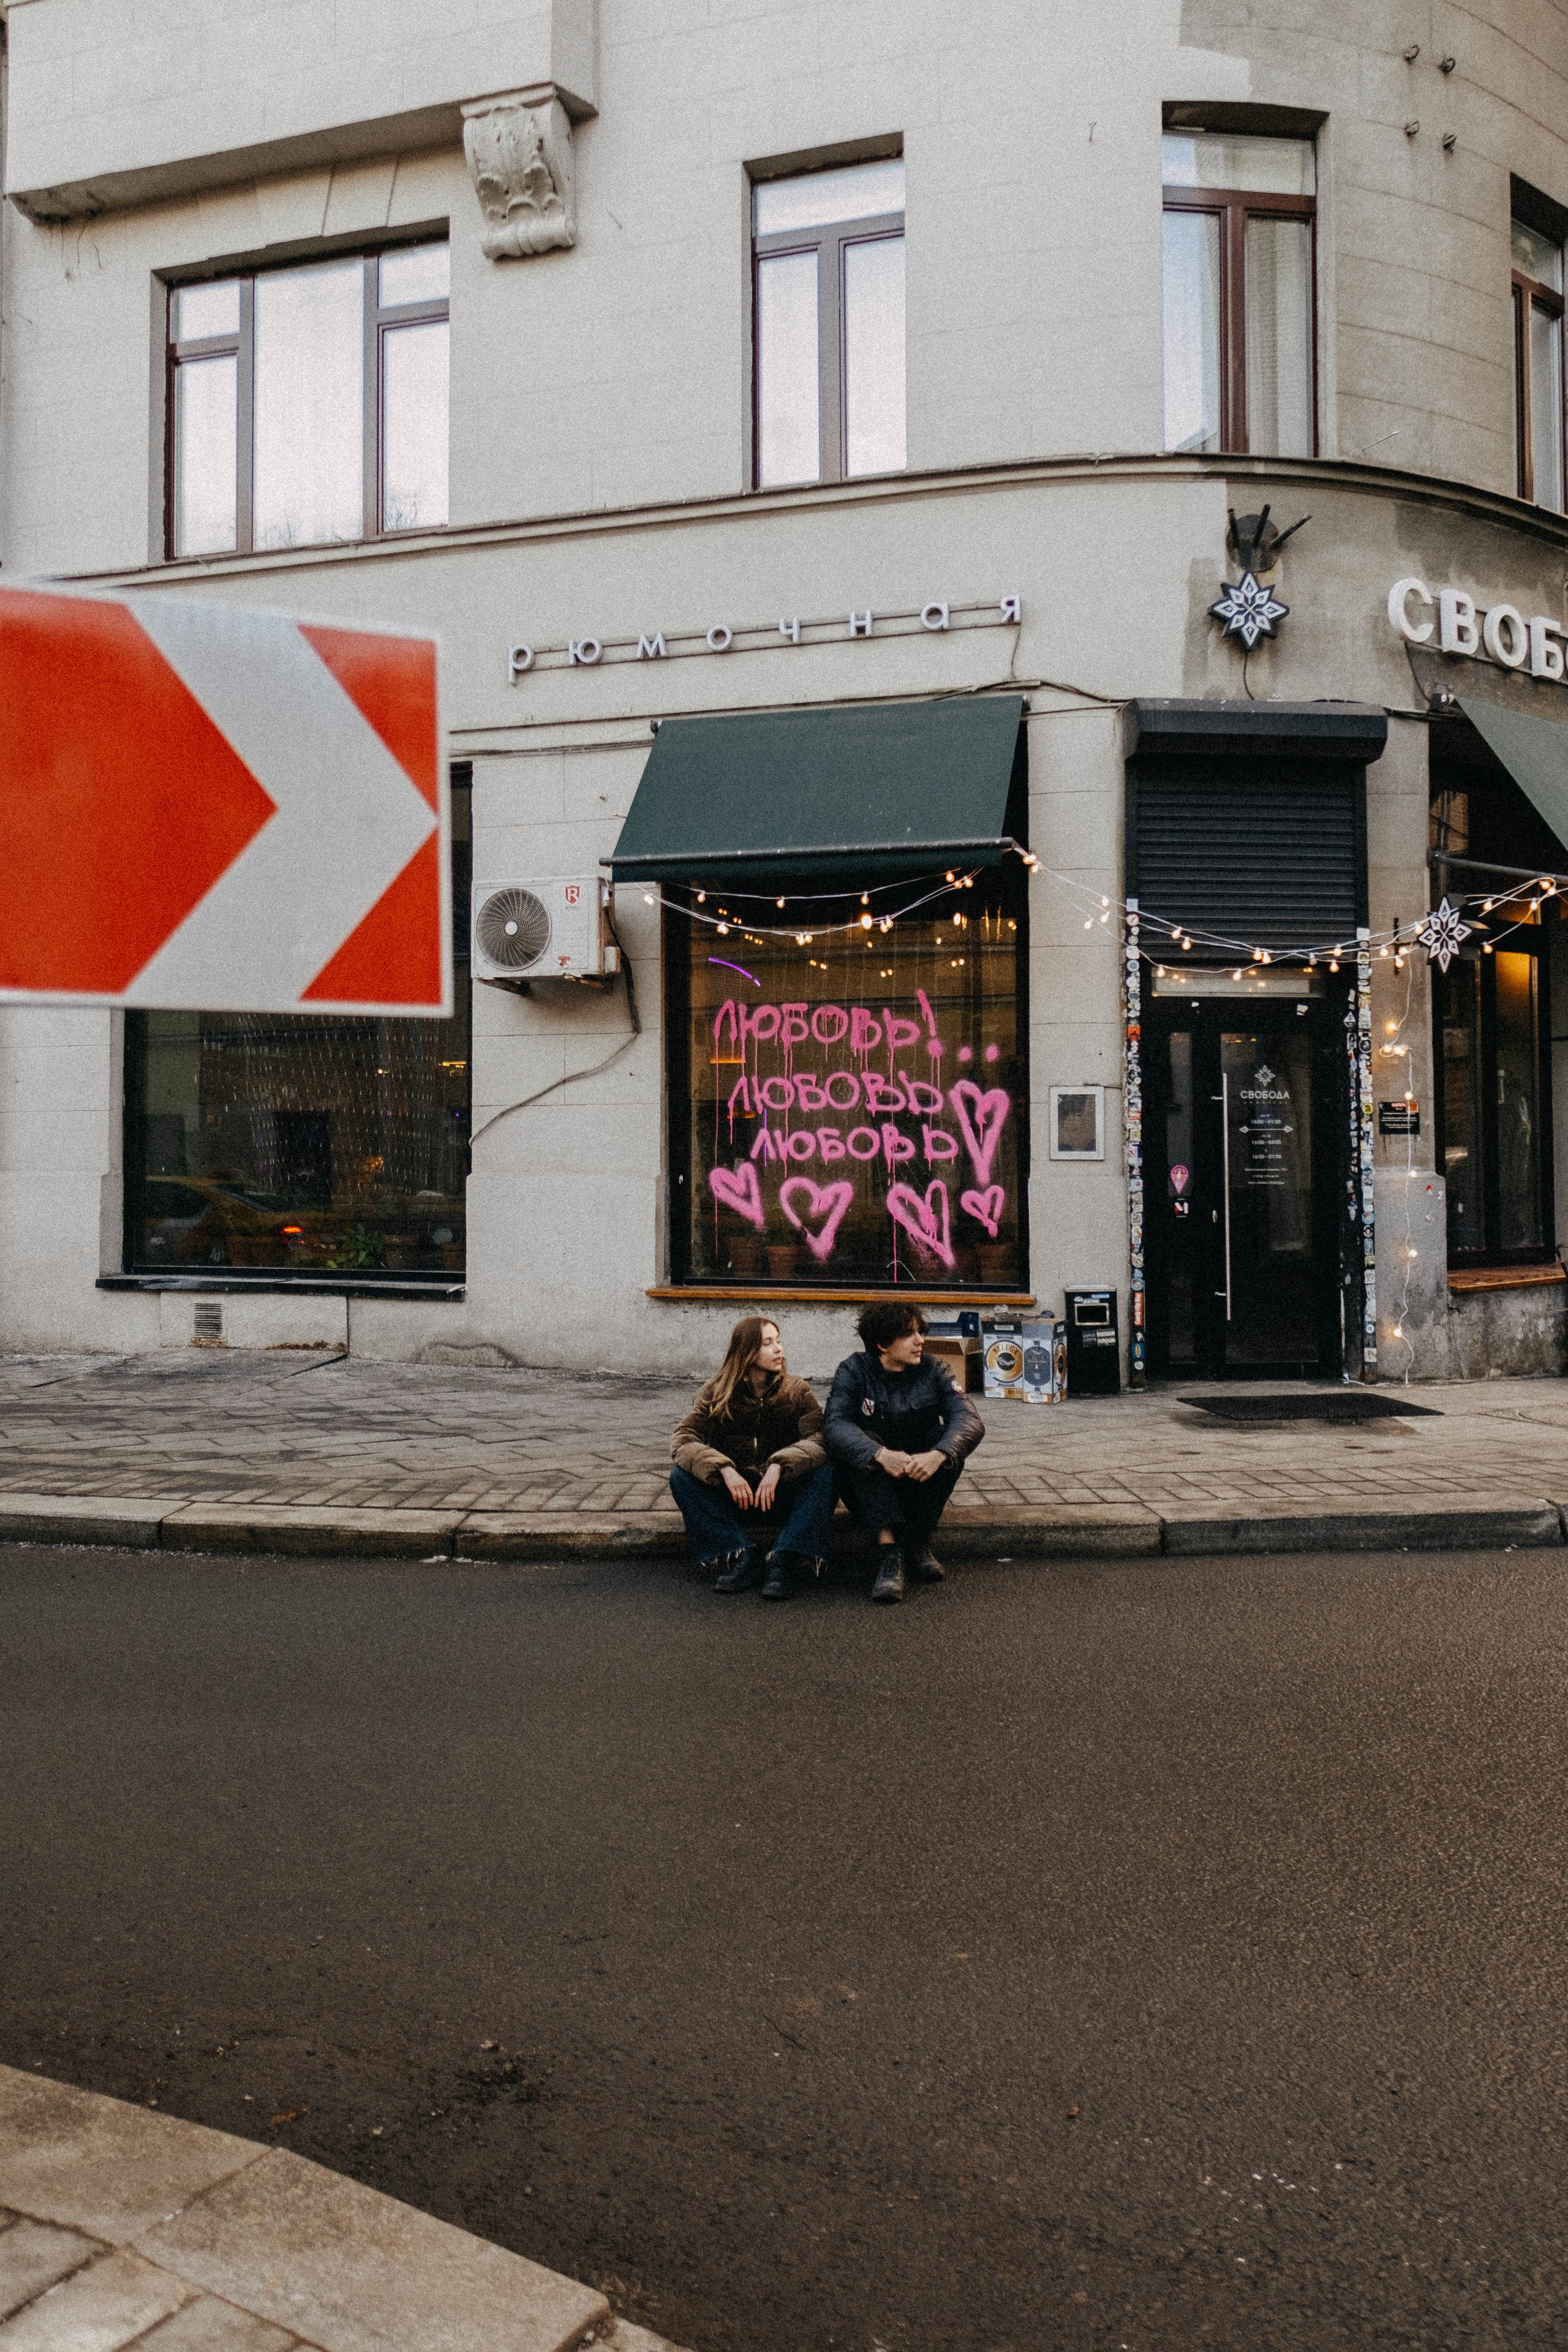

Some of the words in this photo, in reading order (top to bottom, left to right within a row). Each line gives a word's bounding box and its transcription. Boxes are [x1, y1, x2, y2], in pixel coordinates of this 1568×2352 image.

[507, 594, 1022, 685] рюмочная
[1387, 577, 1568, 679] СВОБ
[728, 1070, 944, 1117] ЛЮБОВЬ
[1240, 1091, 1291, 1099] СВОБОДА
[750, 1123, 959, 1164] ЛЮБОВЬ
